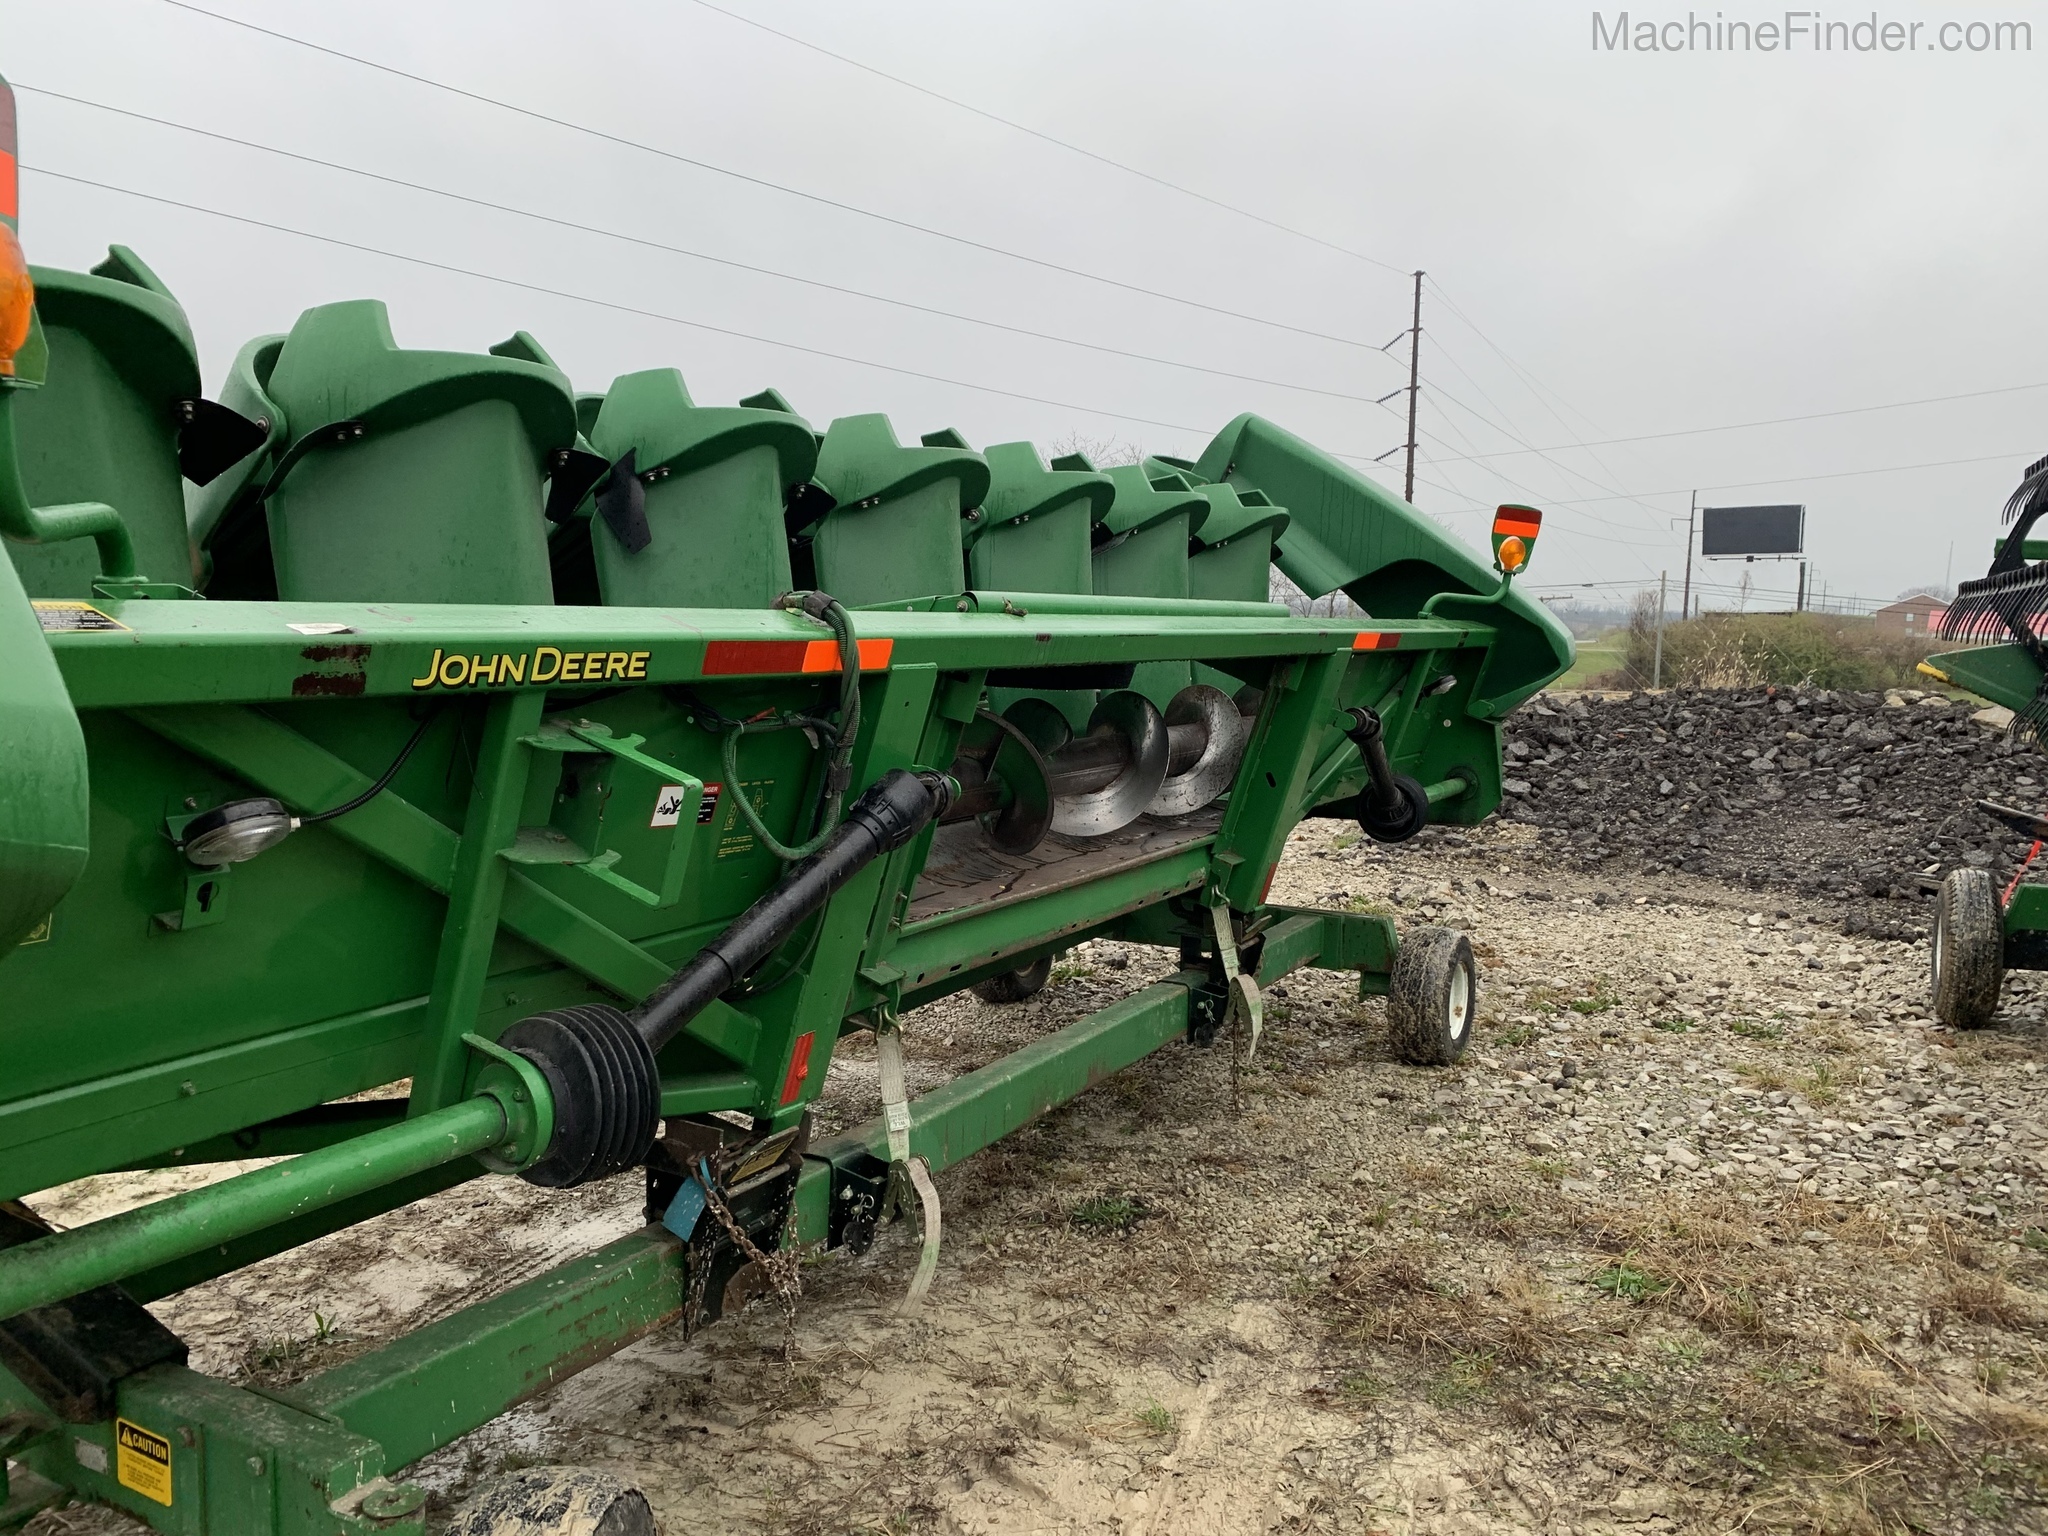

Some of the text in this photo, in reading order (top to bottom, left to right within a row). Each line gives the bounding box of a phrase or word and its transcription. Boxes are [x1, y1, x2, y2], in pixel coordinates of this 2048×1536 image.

[412, 646, 651, 688] JOHN DEERE
[132, 1433, 167, 1461] CAUTION
